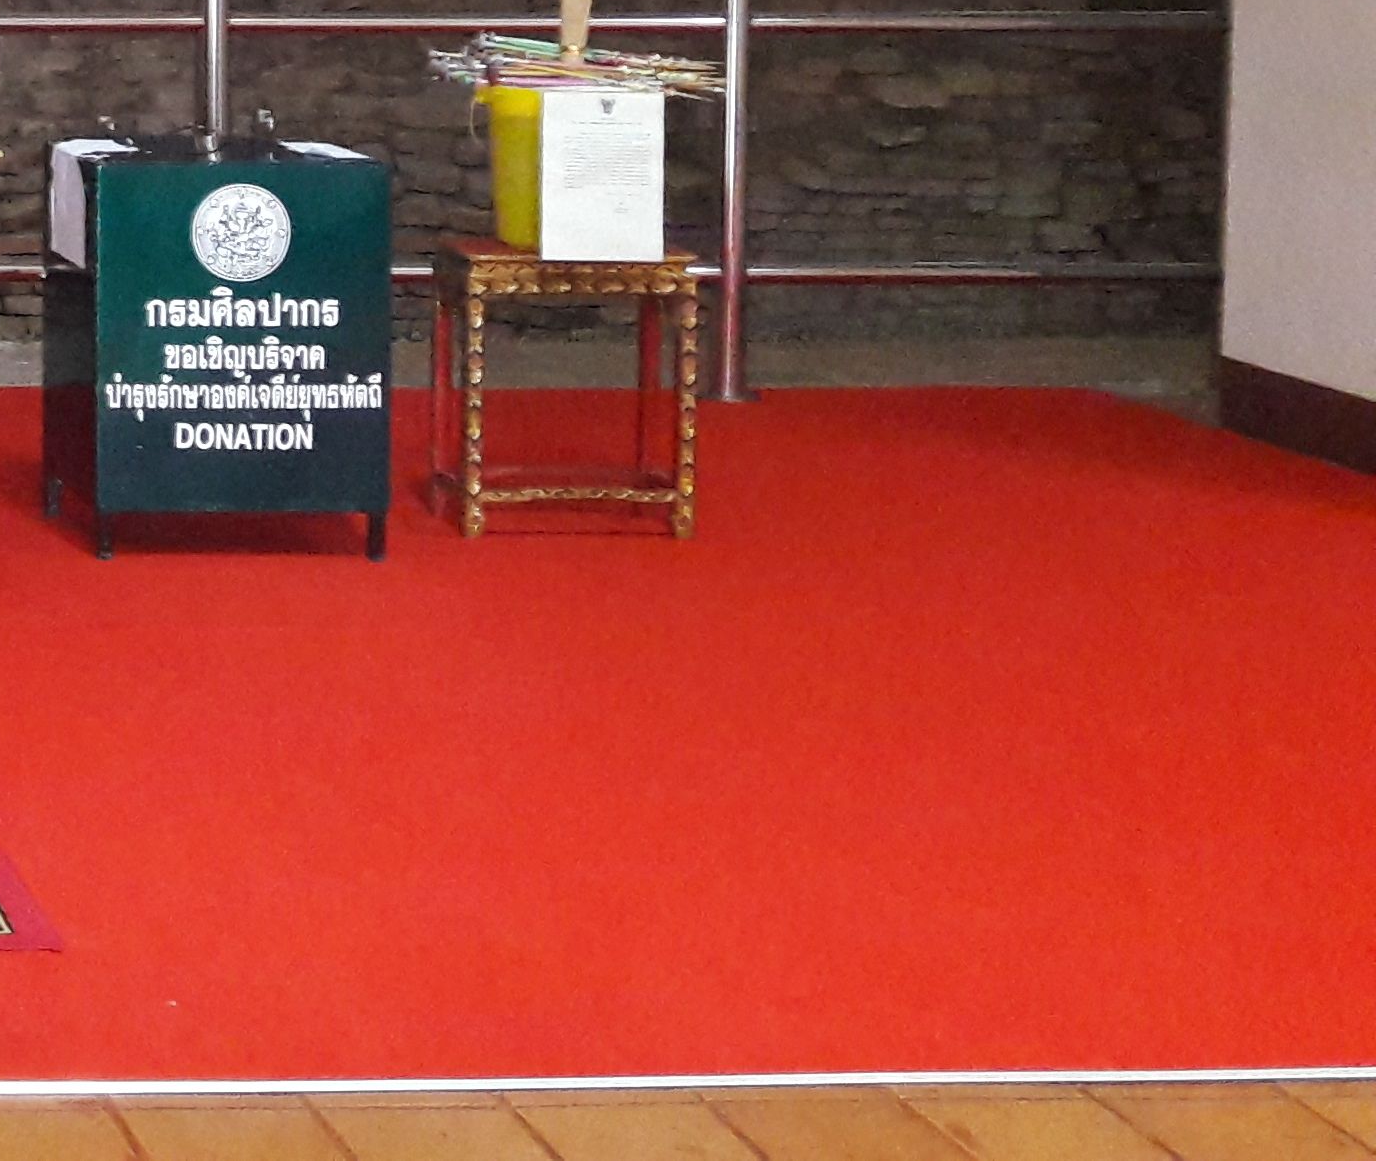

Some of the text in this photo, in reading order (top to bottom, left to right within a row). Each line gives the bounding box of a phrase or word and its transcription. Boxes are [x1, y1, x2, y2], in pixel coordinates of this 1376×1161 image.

[146, 286, 340, 327] กรมศิลปากร
[164, 336, 325, 376] ขอเชิญบริจาค
[105, 371, 383, 422] บำรุงรักษาองค์เจดีย์ยุทธหัตถี
[174, 422, 314, 451] DONATION
